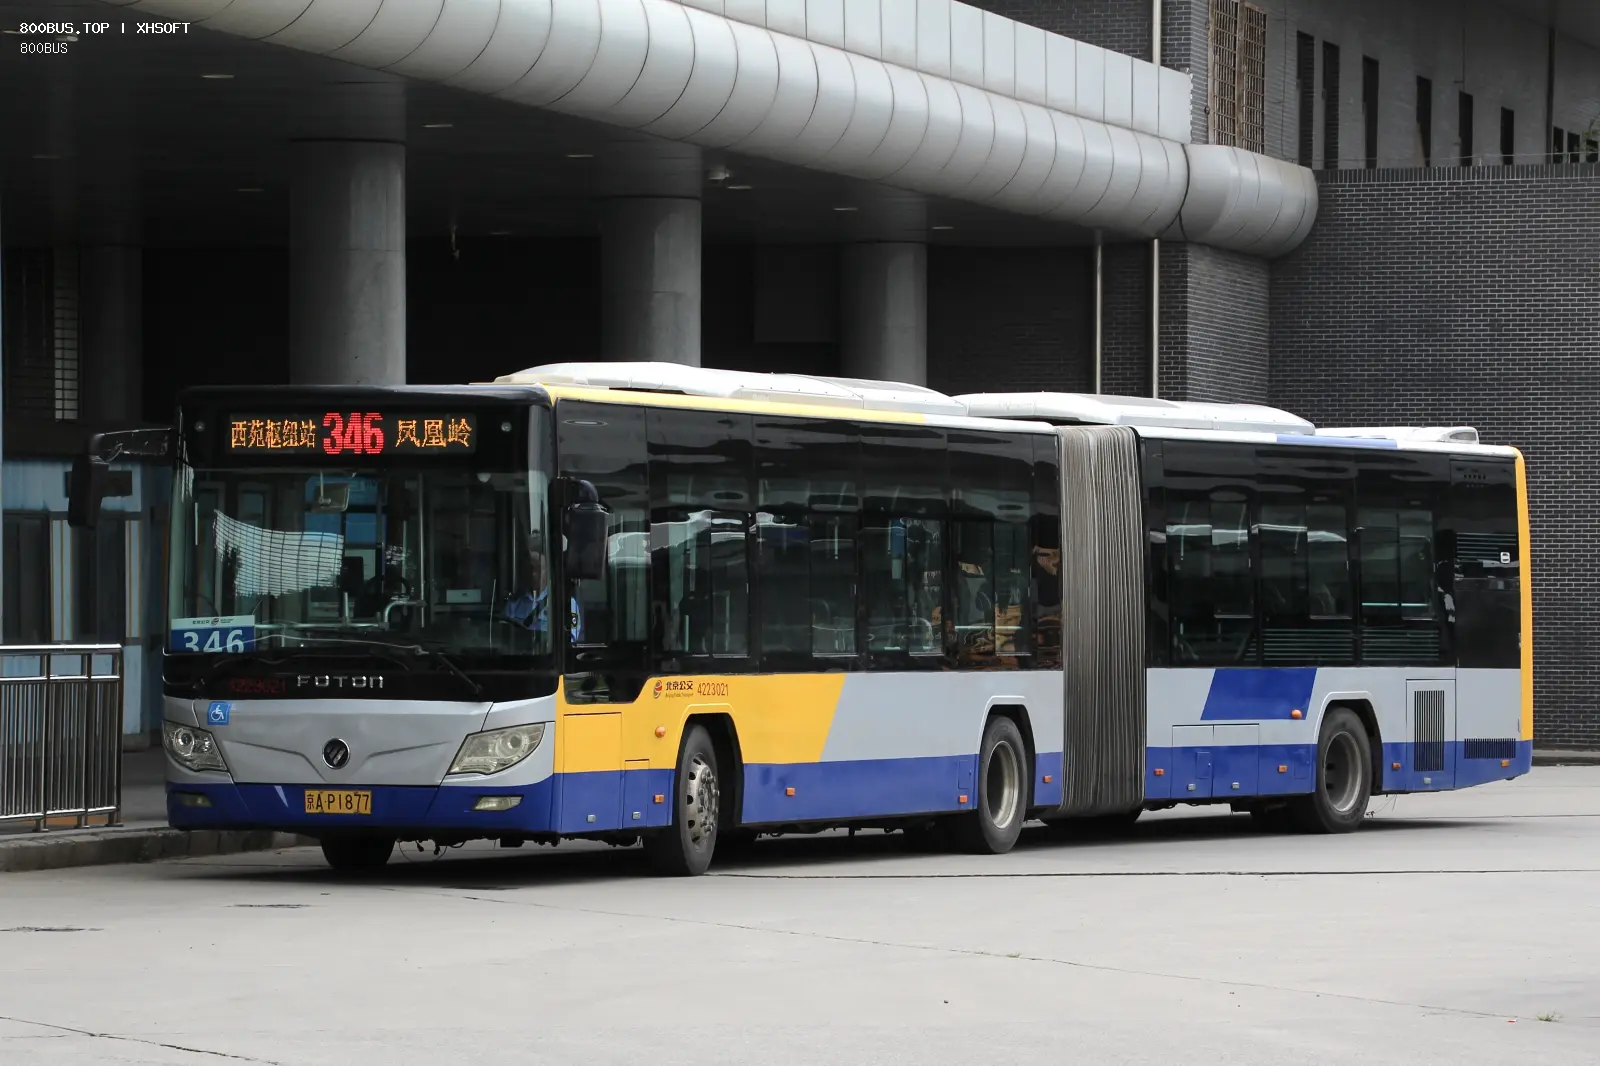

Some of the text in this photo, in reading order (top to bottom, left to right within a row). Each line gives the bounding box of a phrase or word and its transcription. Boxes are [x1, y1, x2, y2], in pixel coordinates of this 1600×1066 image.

[231, 412, 473, 454] 西苑枢纽站 346 凤凰岭
[183, 629, 245, 653] 346
[297, 674, 384, 688] FOTON
[666, 680, 693, 691] 北京公交
[697, 682, 729, 696] 4223021
